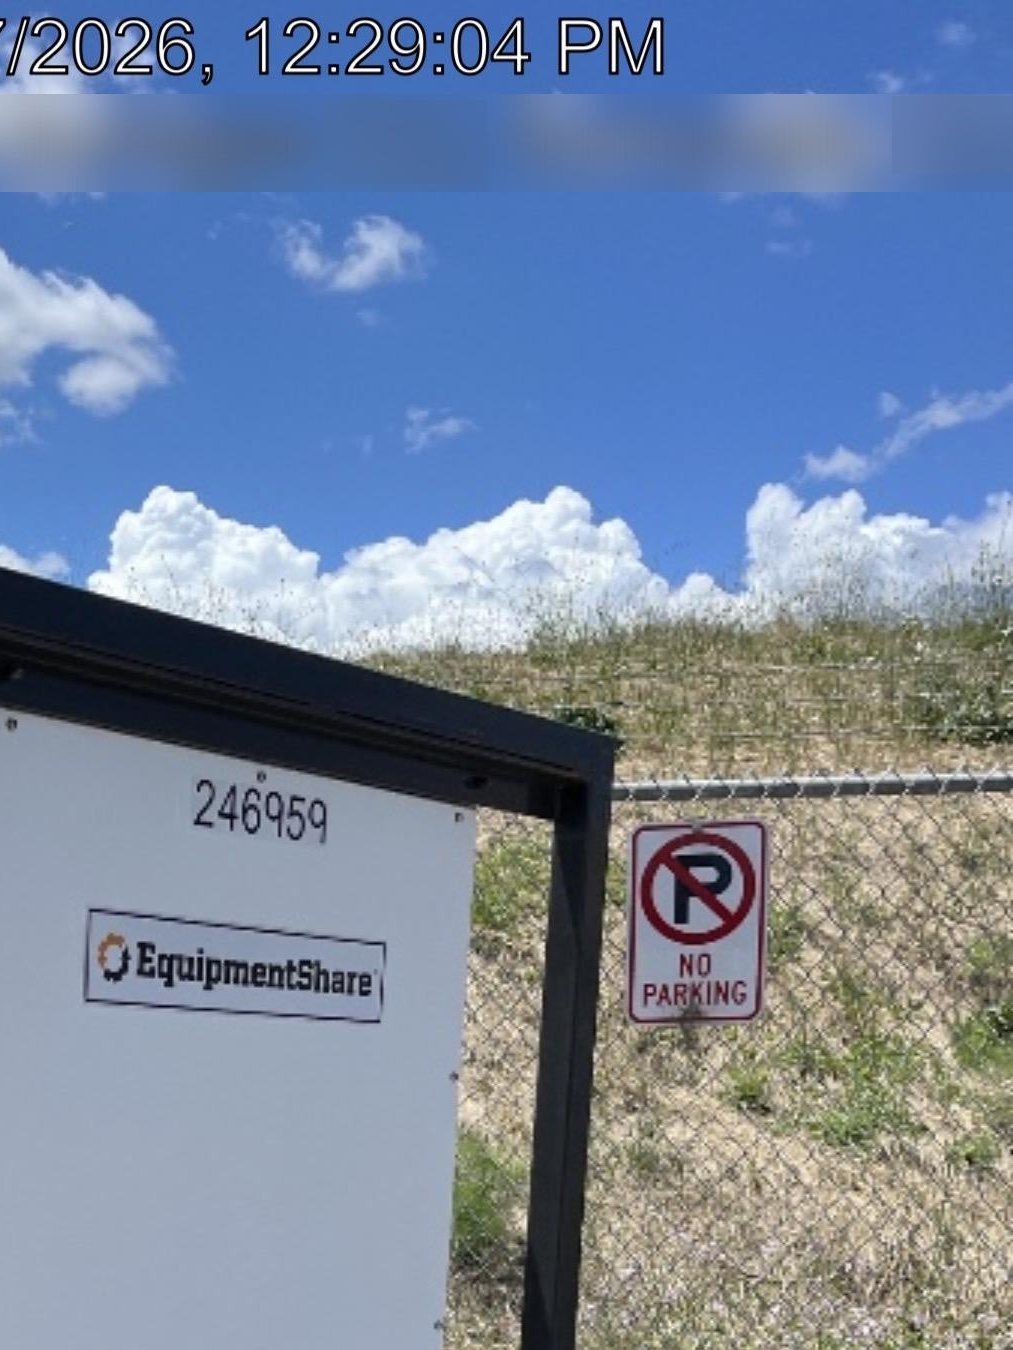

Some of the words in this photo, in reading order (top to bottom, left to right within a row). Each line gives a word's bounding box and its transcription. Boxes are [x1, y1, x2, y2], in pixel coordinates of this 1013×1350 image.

[192, 778, 329, 845] 246959
[135, 941, 373, 997] EquipmentShare
[679, 953, 712, 979] NO
[643, 981, 748, 1008] PARKING
